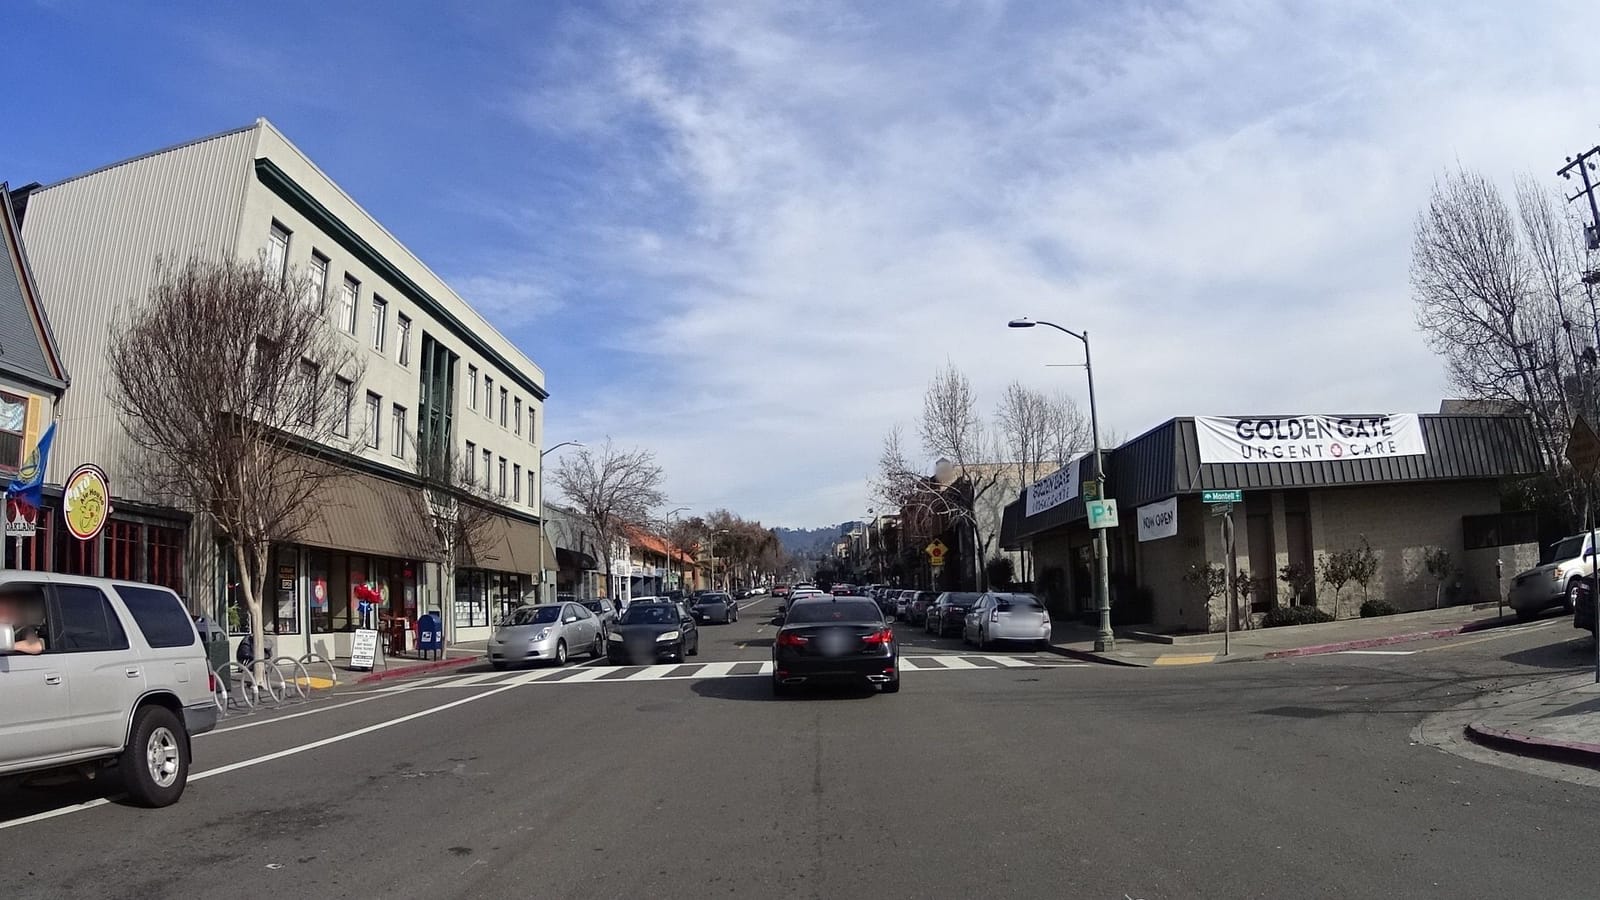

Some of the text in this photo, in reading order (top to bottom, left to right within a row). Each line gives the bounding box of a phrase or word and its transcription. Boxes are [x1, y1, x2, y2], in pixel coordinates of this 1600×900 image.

[1236, 417, 1393, 441] GOLDEN GATE
[1240, 440, 1397, 459] URGENT CARE
[6, 522, 36, 532] OAKLAND
[1155, 510, 1174, 527] OPEN
